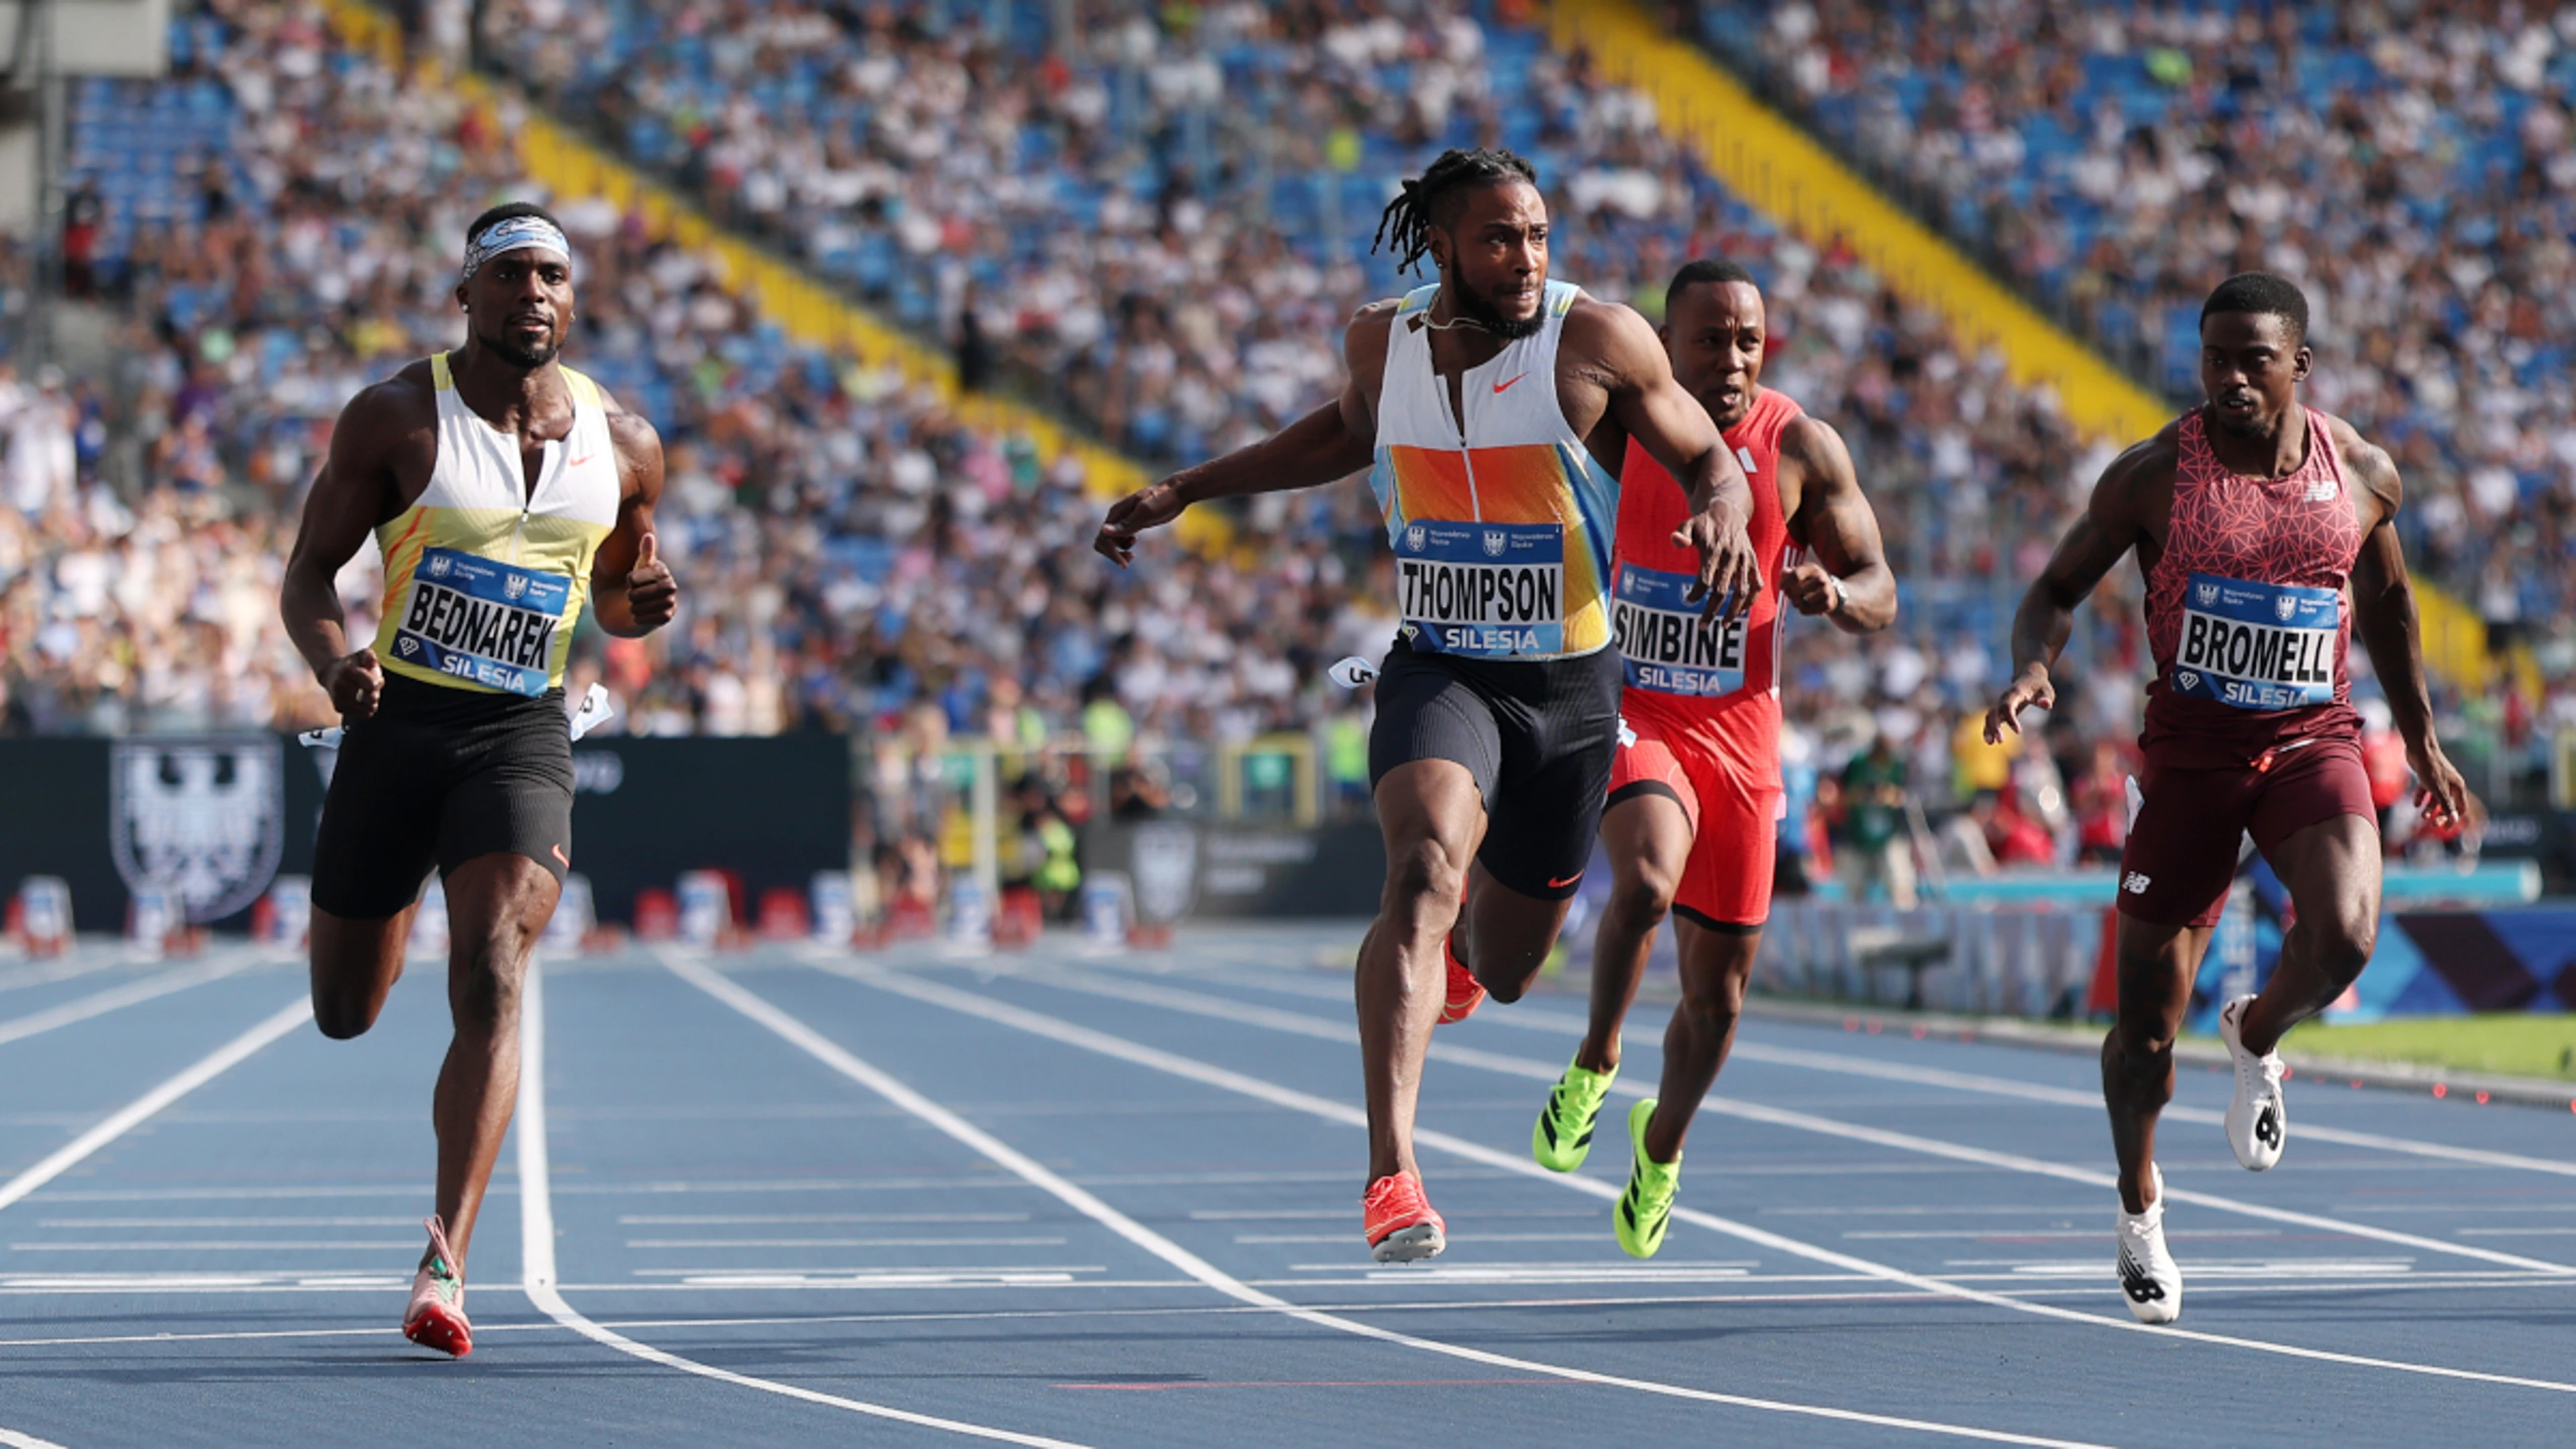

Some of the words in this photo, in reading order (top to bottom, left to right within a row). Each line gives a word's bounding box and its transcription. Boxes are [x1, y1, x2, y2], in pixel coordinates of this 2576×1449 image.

[1403, 562, 1555, 622] THOMPSON
[407, 584, 557, 669] BEDNAREK
[1446, 629, 1540, 649] SILESIA
[1614, 603, 1742, 669] SIMBINE
[2184, 614, 2328, 683] BROMELL
[440, 654, 526, 692] SILESIA
[1639, 667, 1721, 692] SILESIA
[2224, 682, 2310, 706] SILESIA
